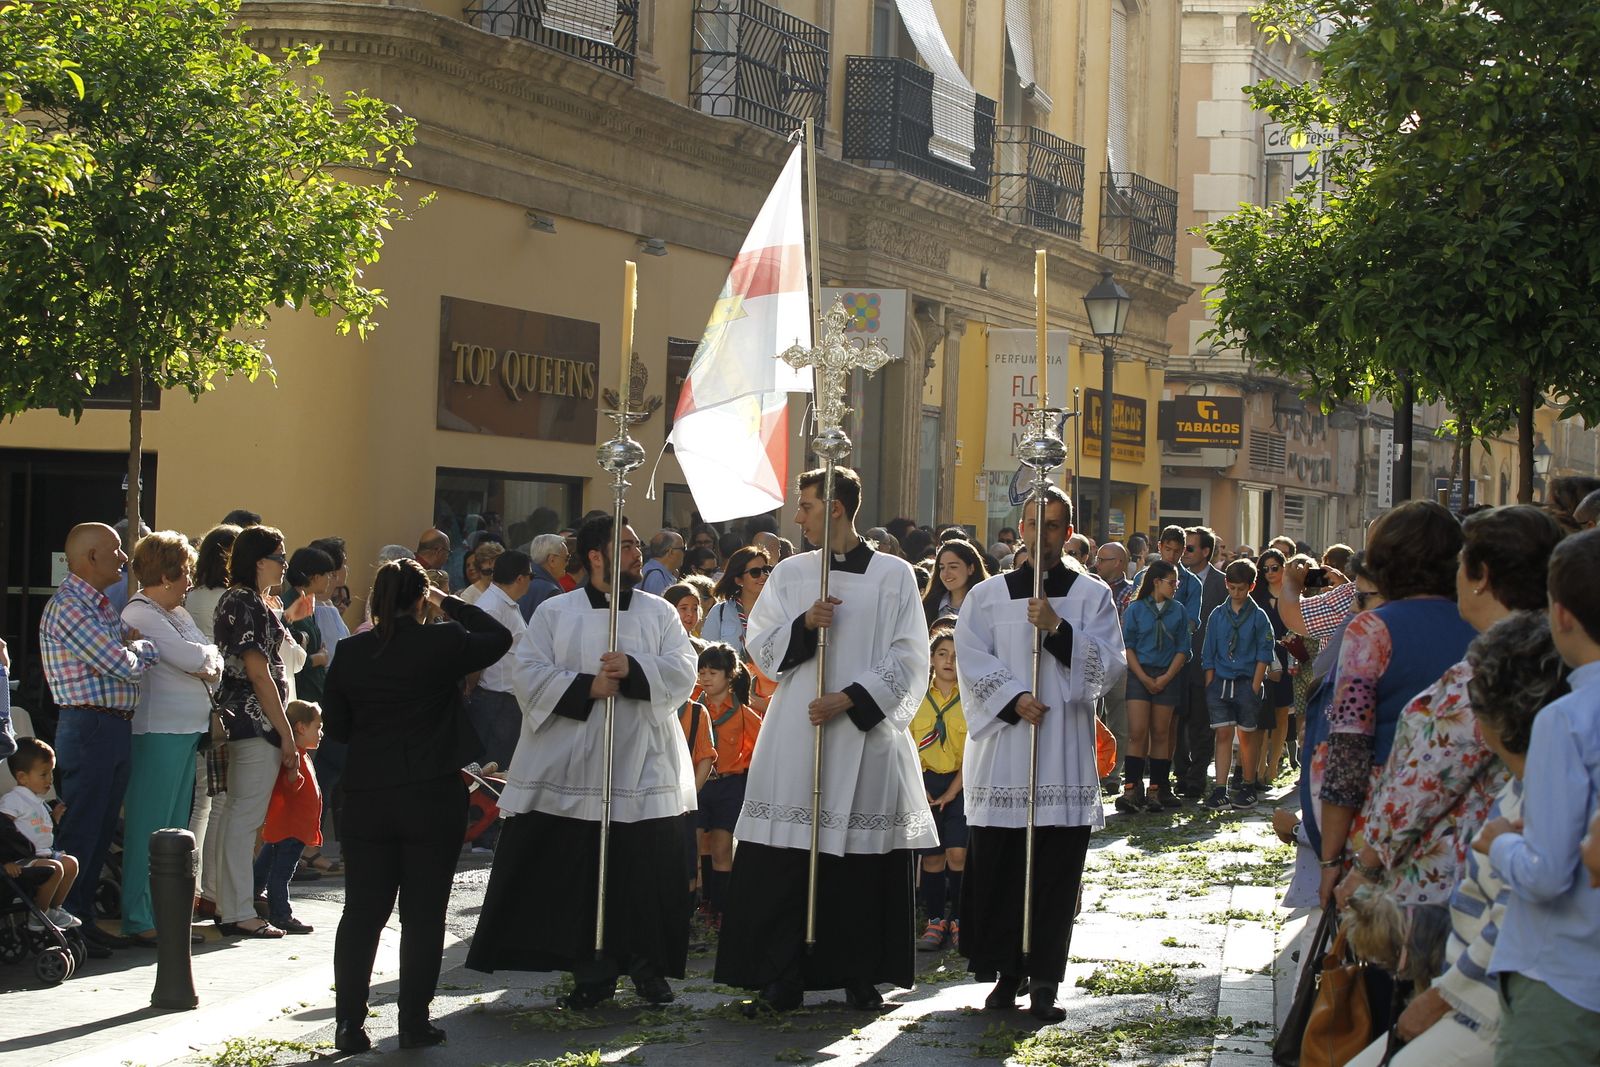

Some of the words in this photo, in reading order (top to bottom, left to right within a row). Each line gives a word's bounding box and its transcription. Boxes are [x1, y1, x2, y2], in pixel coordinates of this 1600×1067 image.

[994, 354, 1062, 364] PERFUMRIA
[452, 341, 496, 387] TOP
[502, 350, 595, 401] QUEENS
[1111, 400, 1142, 432] BACOS
[1176, 421, 1240, 433] TABACOS
